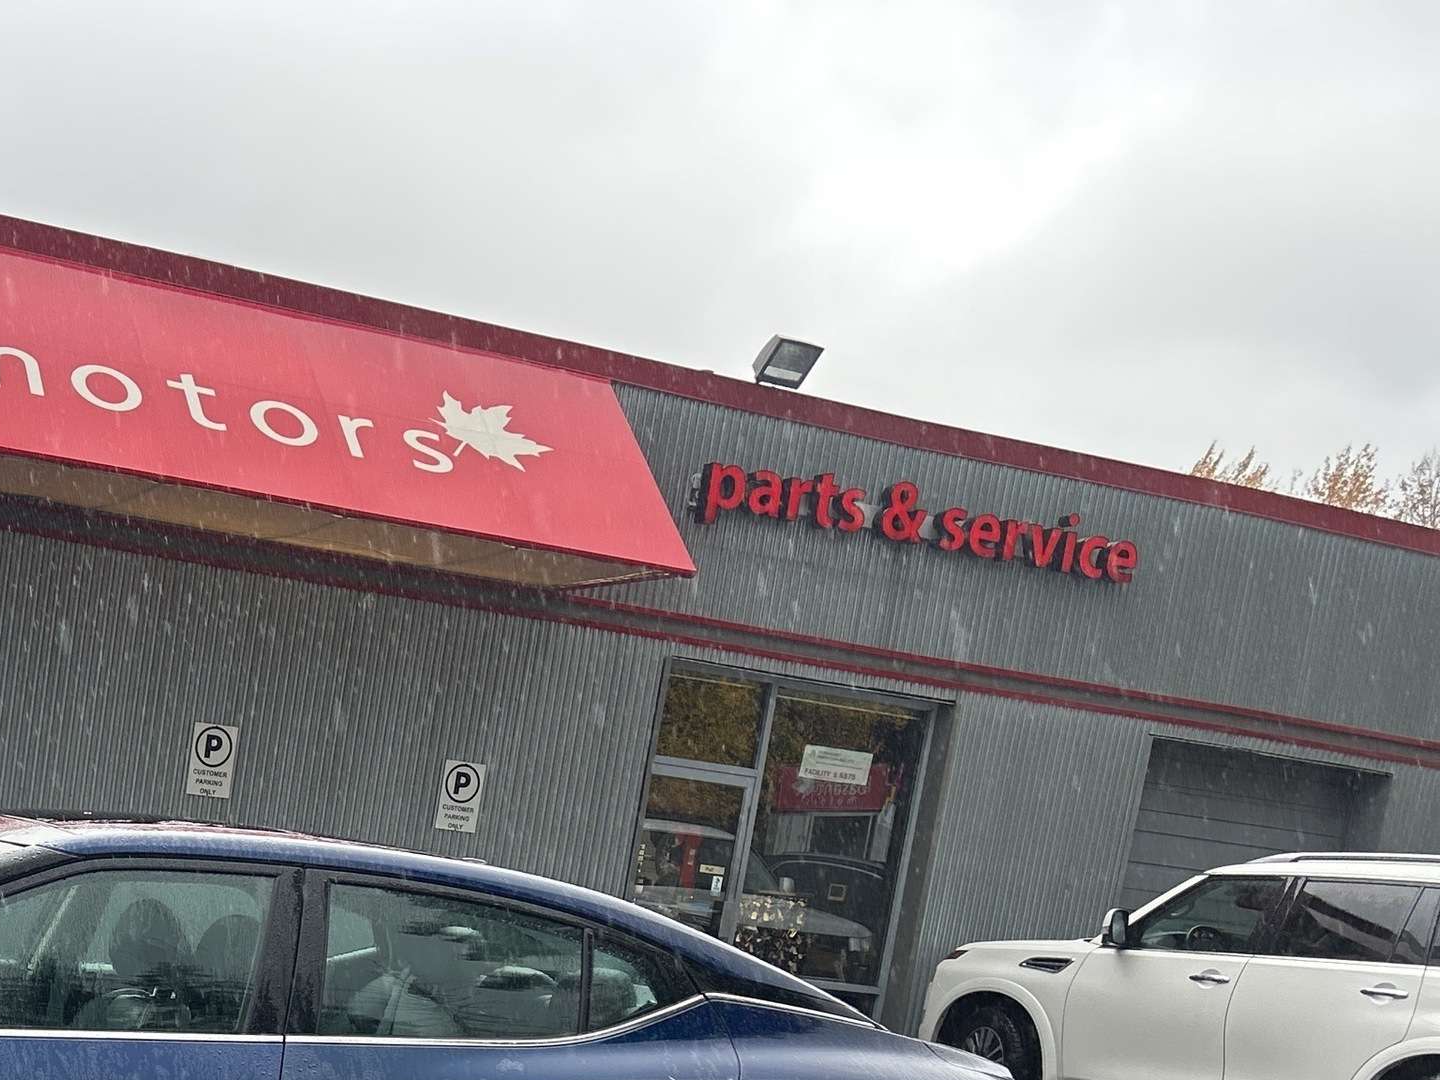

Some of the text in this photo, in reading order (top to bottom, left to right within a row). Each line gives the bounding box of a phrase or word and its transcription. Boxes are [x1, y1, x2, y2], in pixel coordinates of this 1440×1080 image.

[699, 462, 1138, 583] parts & service
[204, 734, 223, 758] P
[193, 768, 228, 778] CUSTOMER
[195, 778, 223, 787] PARKING
[453, 771, 471, 795] P
[200, 787, 216, 796] ONLY
[442, 804, 474, 814] CUSTOMER
[444, 813, 470, 822] PARKING
[448, 822, 463, 830] ONLY
